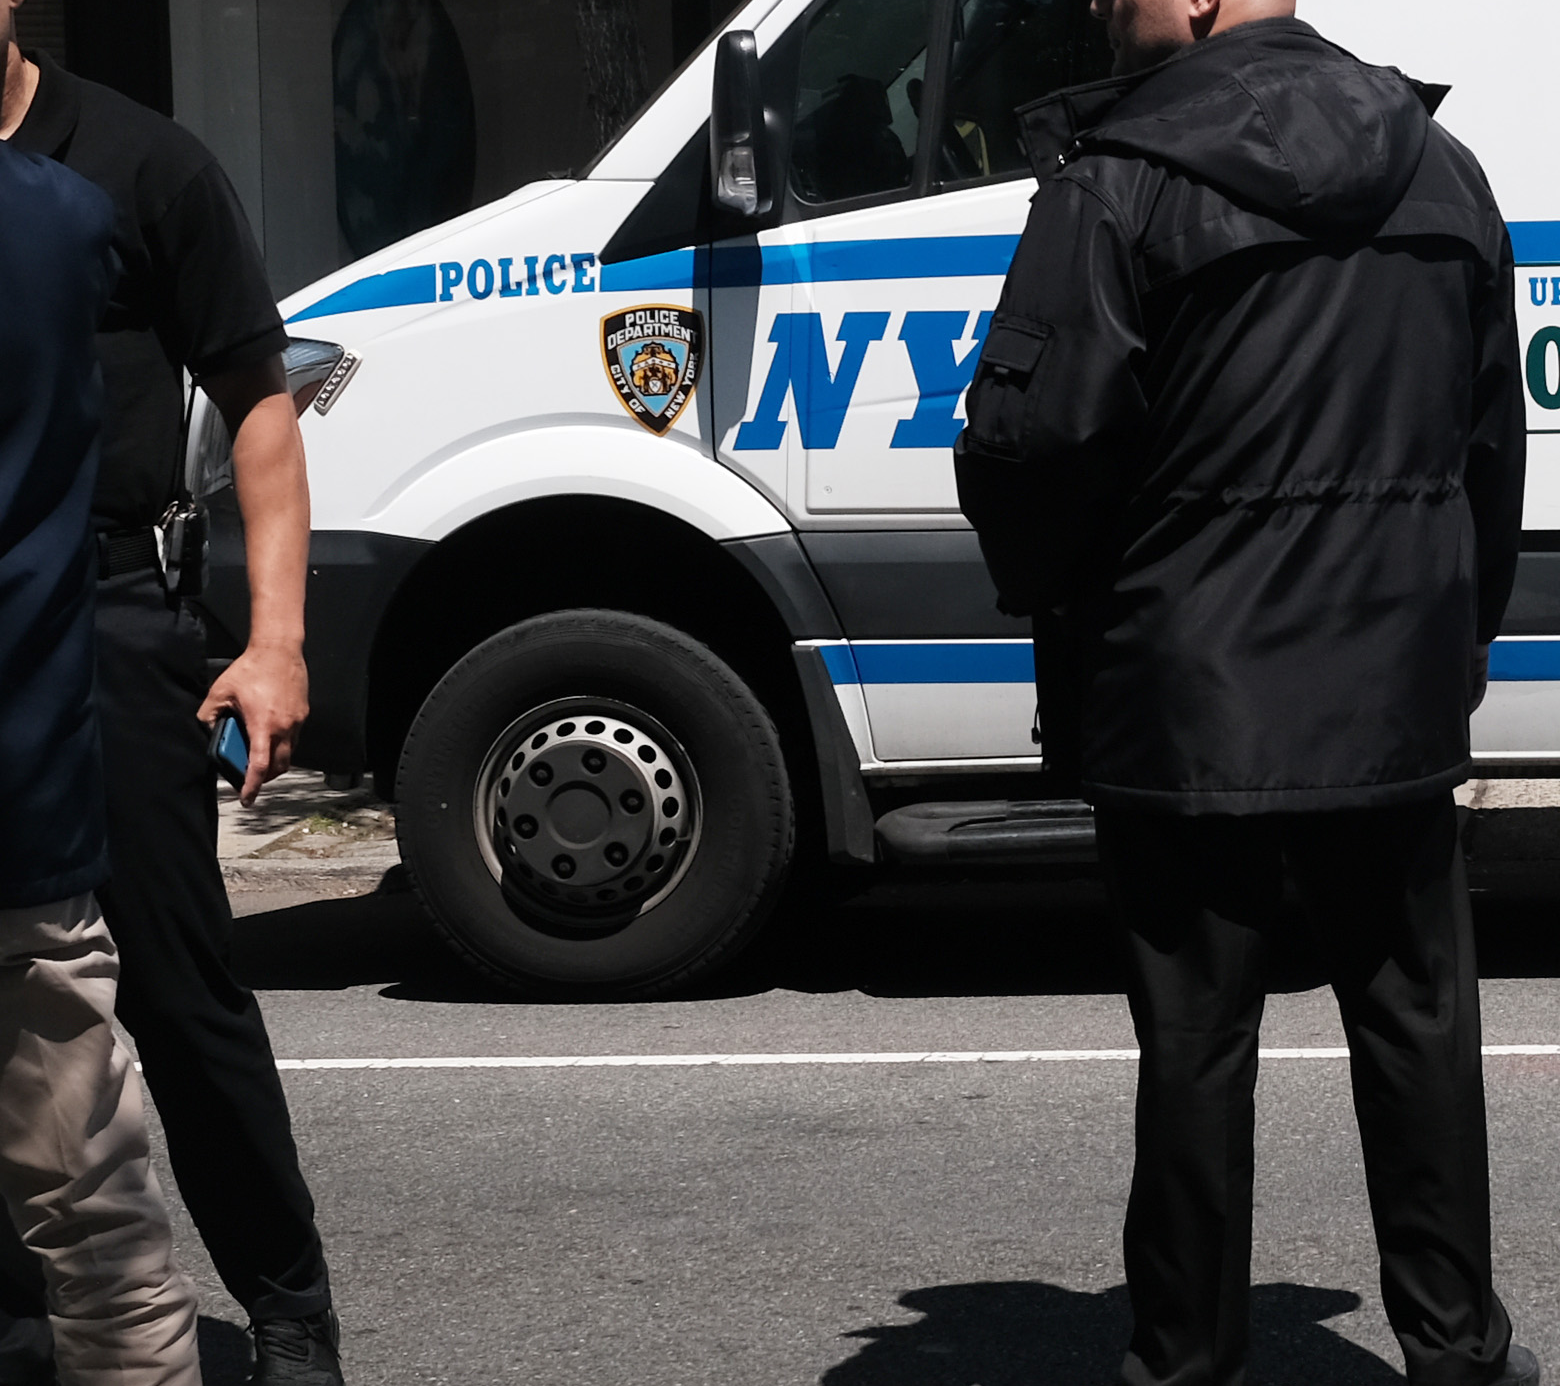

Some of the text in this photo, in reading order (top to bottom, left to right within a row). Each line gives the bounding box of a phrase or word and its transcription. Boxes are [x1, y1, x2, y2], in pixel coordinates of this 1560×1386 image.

[440, 253, 595, 301] POLICE
[625, 310, 679, 327] POLICE
[607, 324, 698, 350] DEPARTMENT
[611, 364, 646, 413] CITY OF
[664, 391, 686, 419] NEW
